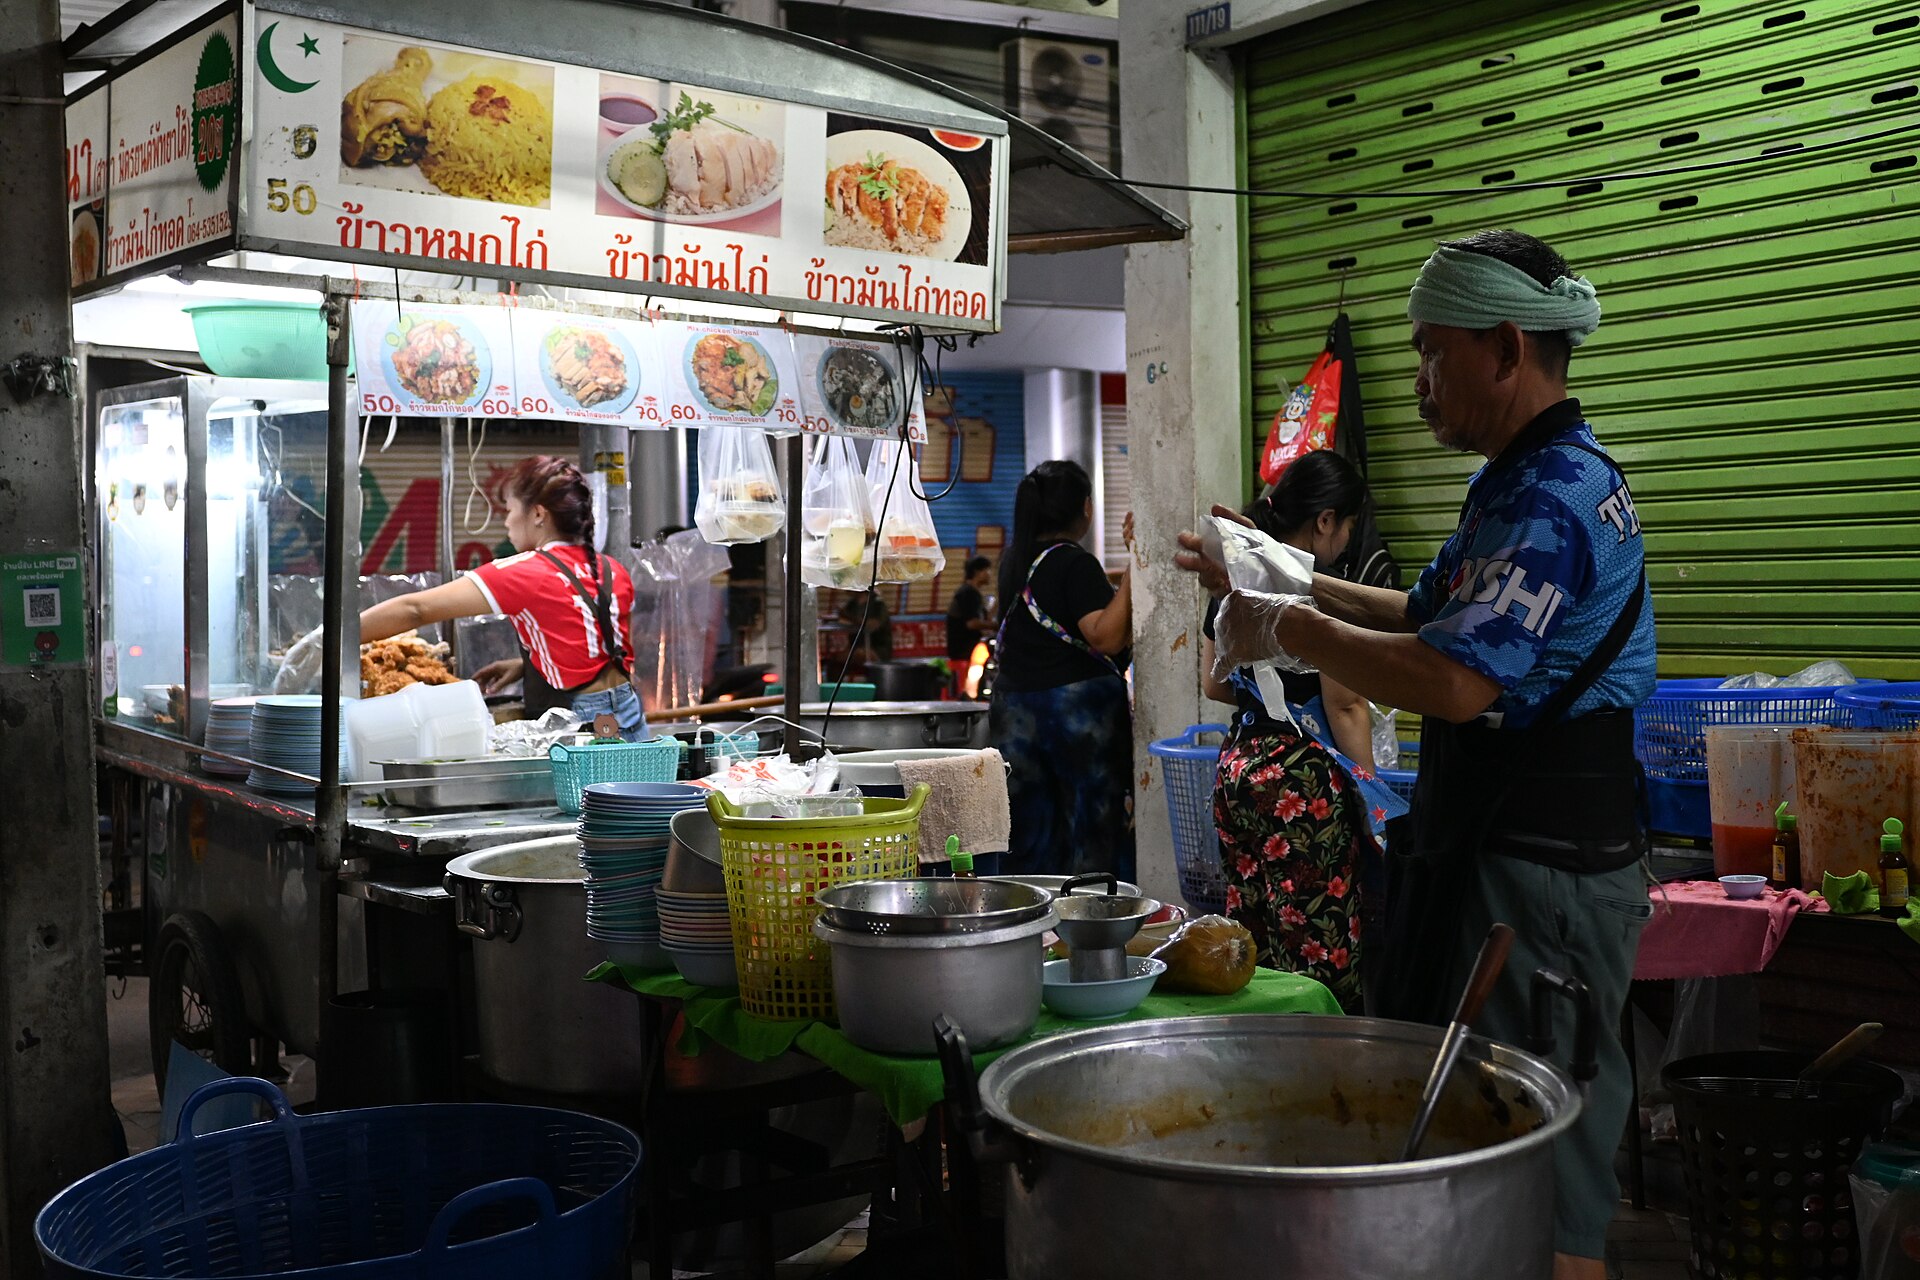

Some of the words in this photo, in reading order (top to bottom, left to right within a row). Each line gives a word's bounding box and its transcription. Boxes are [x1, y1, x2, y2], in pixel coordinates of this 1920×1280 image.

[1189, 7, 1226, 37] 111/19
[267, 178, 318, 216] 50
[107, 207, 184, 269] ข้าวมันไก่ทอด
[336, 200, 548, 271] ข้าวหมกไก่
[606, 233, 769, 296] ข้าวมันไก่
[804, 257, 987, 320] ข้าวมันไก่ทอด
[34, 560, 55, 569] LINE
